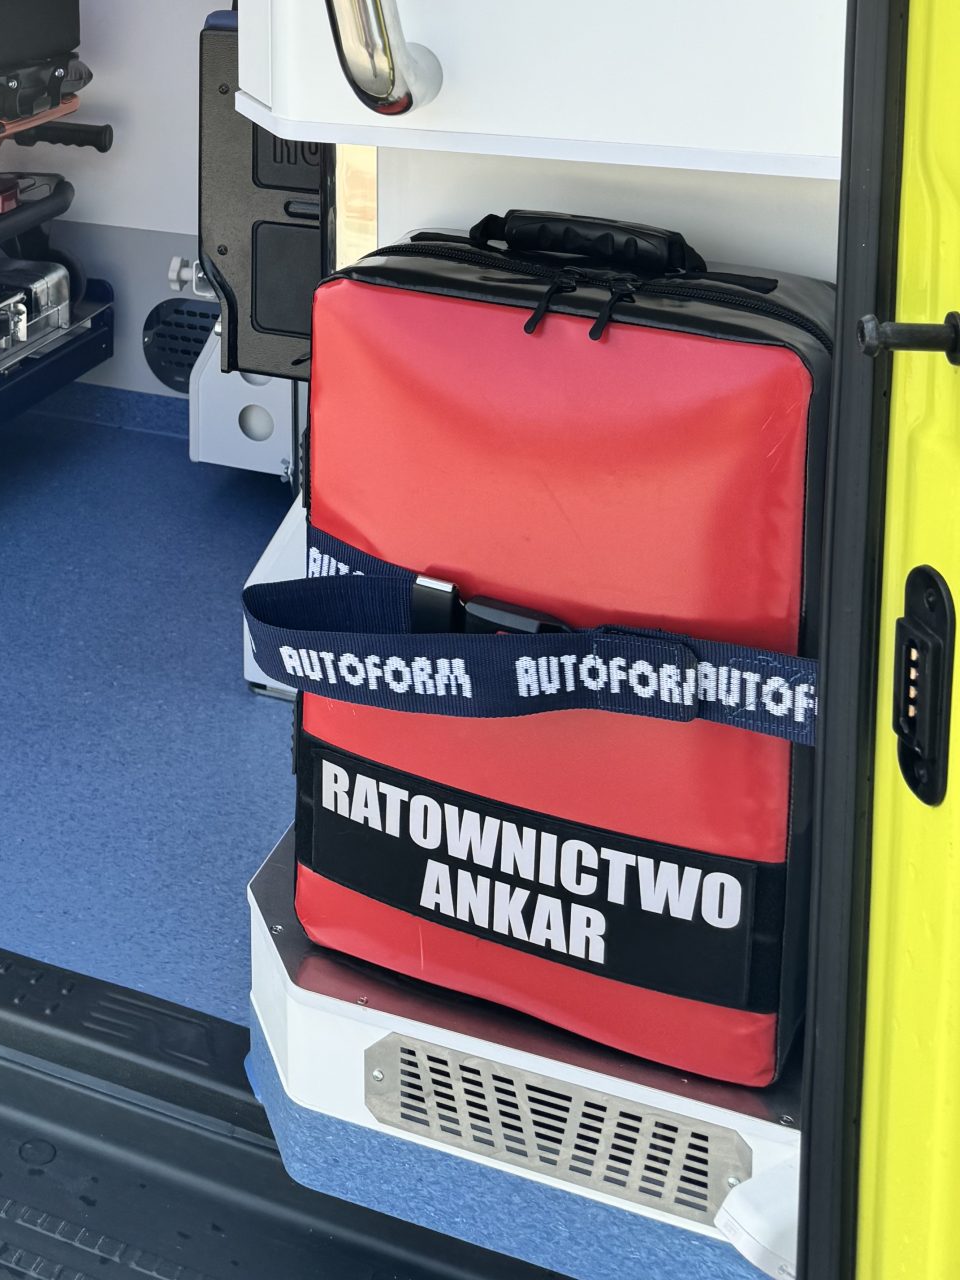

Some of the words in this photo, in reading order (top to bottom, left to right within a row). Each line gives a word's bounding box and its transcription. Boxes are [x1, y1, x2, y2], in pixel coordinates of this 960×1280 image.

[279, 645, 473, 699] AUTOFORM
[697, 661, 818, 722] AUTOF
[321, 759, 742, 930] RATOWNICTWO
[419, 858, 607, 964] ANKAR
